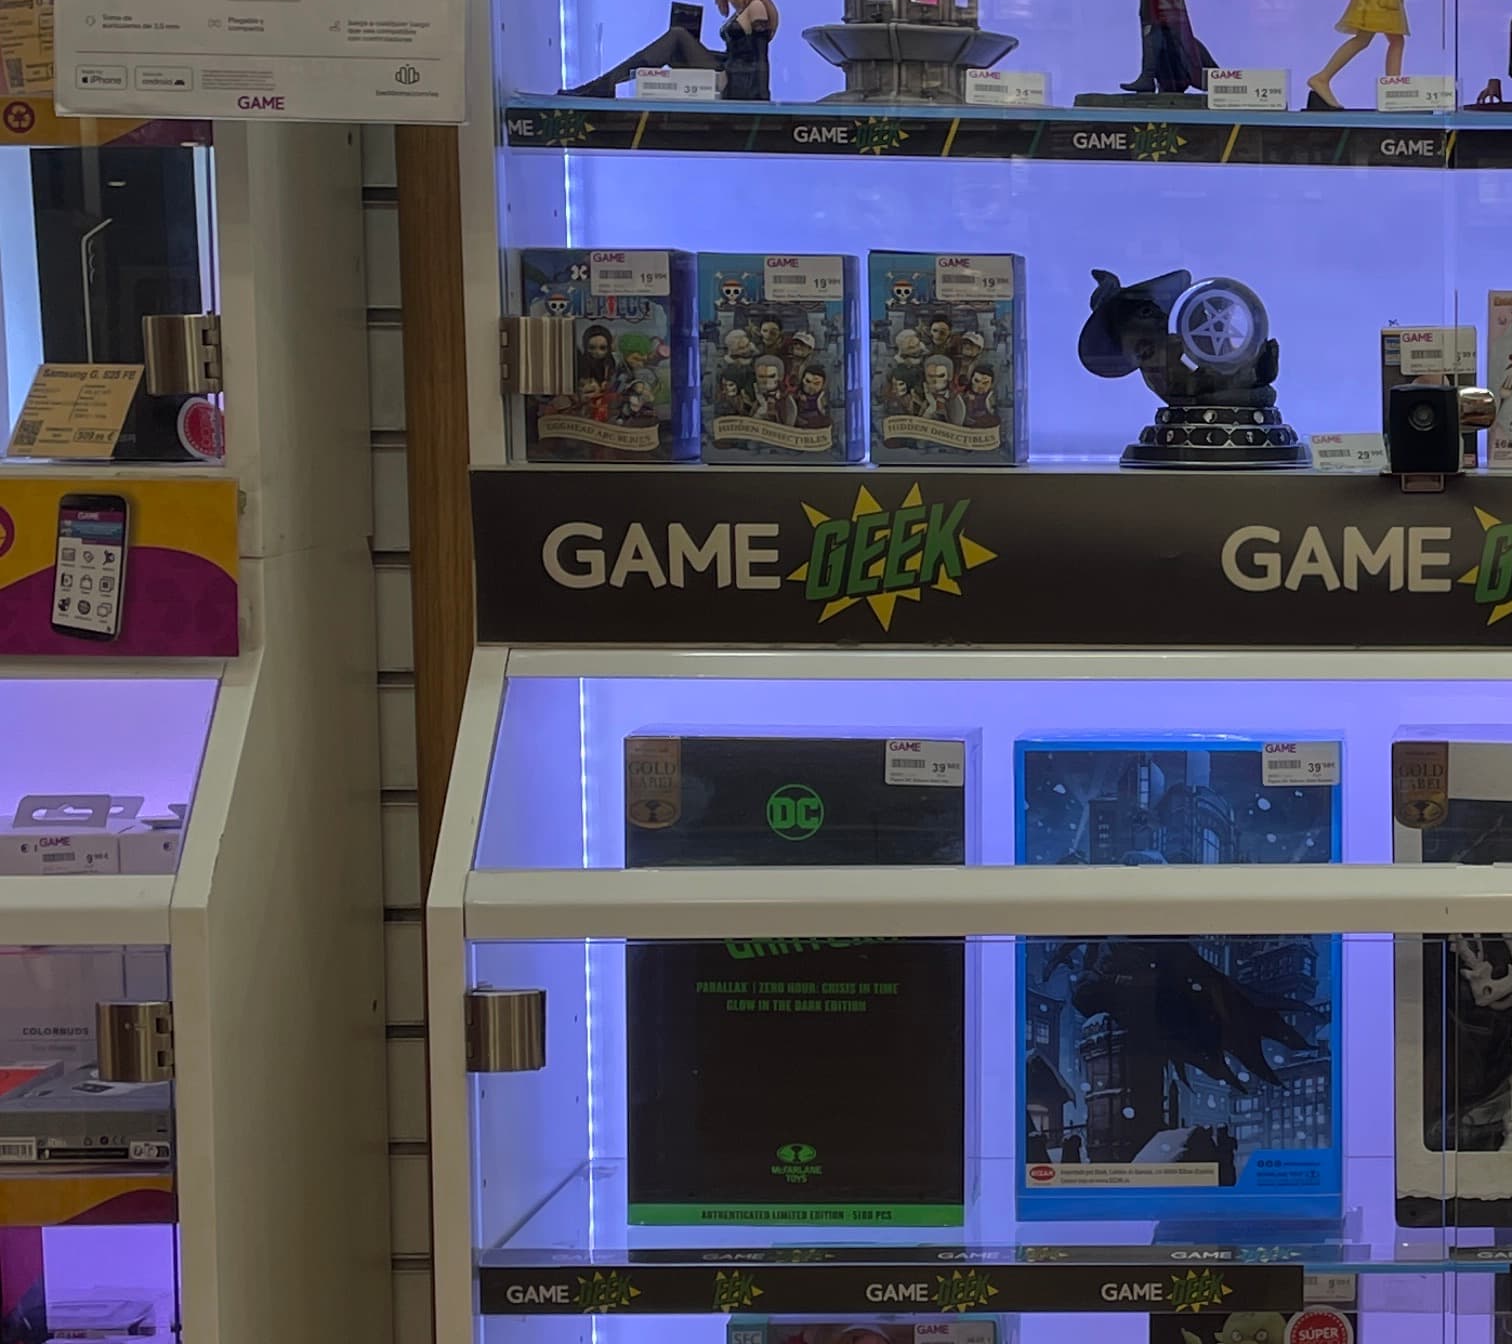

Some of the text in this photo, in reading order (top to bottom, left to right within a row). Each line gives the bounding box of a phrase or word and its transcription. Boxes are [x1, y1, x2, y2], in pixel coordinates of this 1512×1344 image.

[1211, 69, 1242, 80] GAME
[238, 96, 284, 110] GAME
[793, 126, 848, 143] GAME
[593, 253, 625, 263] GAME
[939, 259, 970, 268] GAME
[543, 499, 970, 601] GAME GEEK
[1222, 526, 1450, 592] GAME
[889, 742, 921, 752] GAME
[769, 798, 820, 829] DC
[866, 1283, 928, 1302] GAME
[1299, 1327, 1338, 1340] SÚPER
